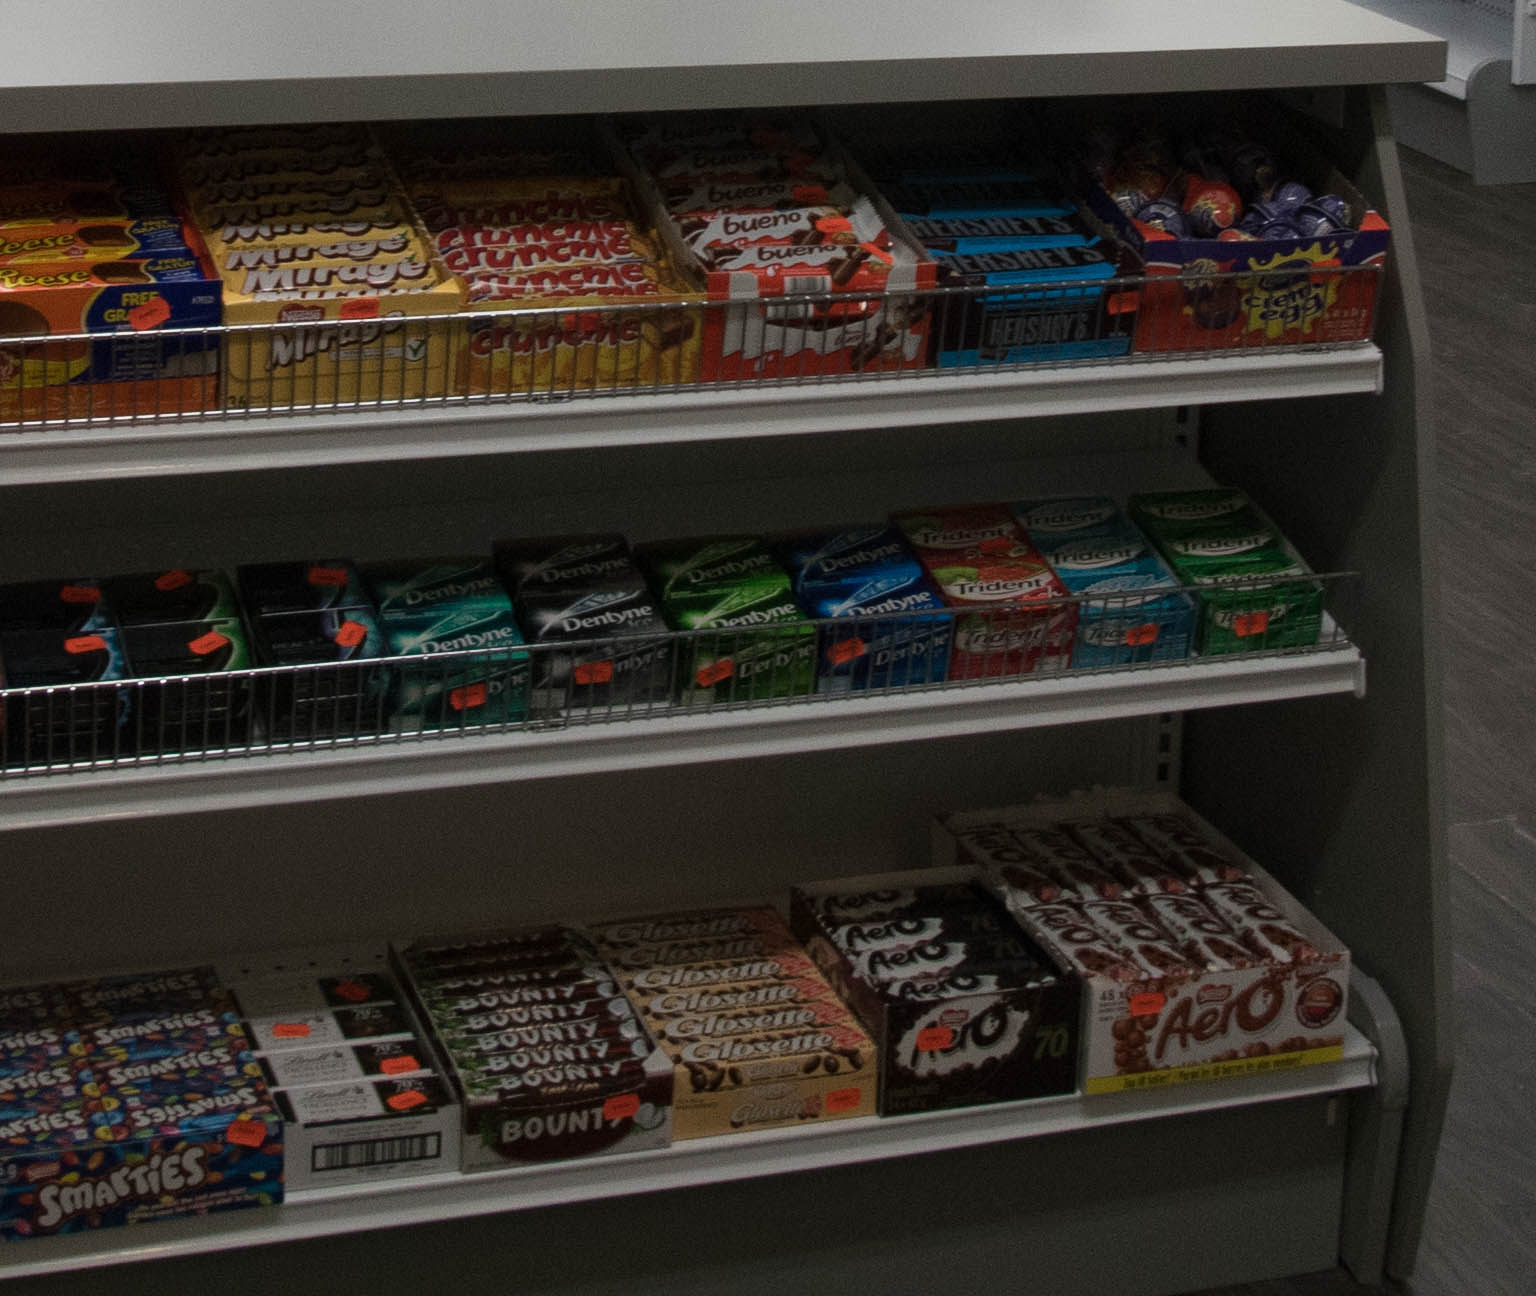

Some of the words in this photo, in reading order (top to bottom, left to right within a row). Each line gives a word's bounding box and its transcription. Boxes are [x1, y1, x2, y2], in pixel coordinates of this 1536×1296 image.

[723, 211, 802, 236] bueno
[914, 216, 1074, 240] HERSHEY'S
[225, 237, 411, 270] Mirage
[942, 245, 1106, 277] HERSHEY'S
[241, 260, 431, 295] Mirage
[266, 310, 406, 371] Mirage
[1026, 509, 1104, 527] Trident
[922, 527, 1007, 544] Trident
[1181, 536, 1267, 552] Trident
[542, 556, 631, 585] Dentyne
[687, 553, 771, 585] Dentyne
[818, 542, 901, 574] Dentyne
[1052, 547, 1139, 563] Trident
[405, 576, 496, 606] Dentyne
[958, 578, 1043, 595] Trident
[564, 604, 654, 633] Dentyne
[713, 602, 798, 630] Dentyne
[848, 590, 932, 618] Dentyne
[420, 625, 514, 656] Dentyne
[845, 916, 926, 948] Aero
[867, 940, 949, 975] Aero
[632, 959, 782, 989] Glosette
[898, 972, 981, 1001] Aero
[459, 985, 576, 1013] BOUNTY
[649, 983, 799, 1014] Glosette
[467, 1001, 588, 1032] BOUNTY
[666, 1007, 817, 1038] Glosette
[1154, 977, 1285, 1062] Aero
[478, 1020, 599, 1051] BOUNTY
[681, 1032, 835, 1064] Glosette
[1034, 1026, 1070, 1059] 70
[488, 1039, 610, 1072] BOUNTY
[500, 1060, 623, 1090] BOUNTY
[36, 1146, 208, 1228] SMARTIES
